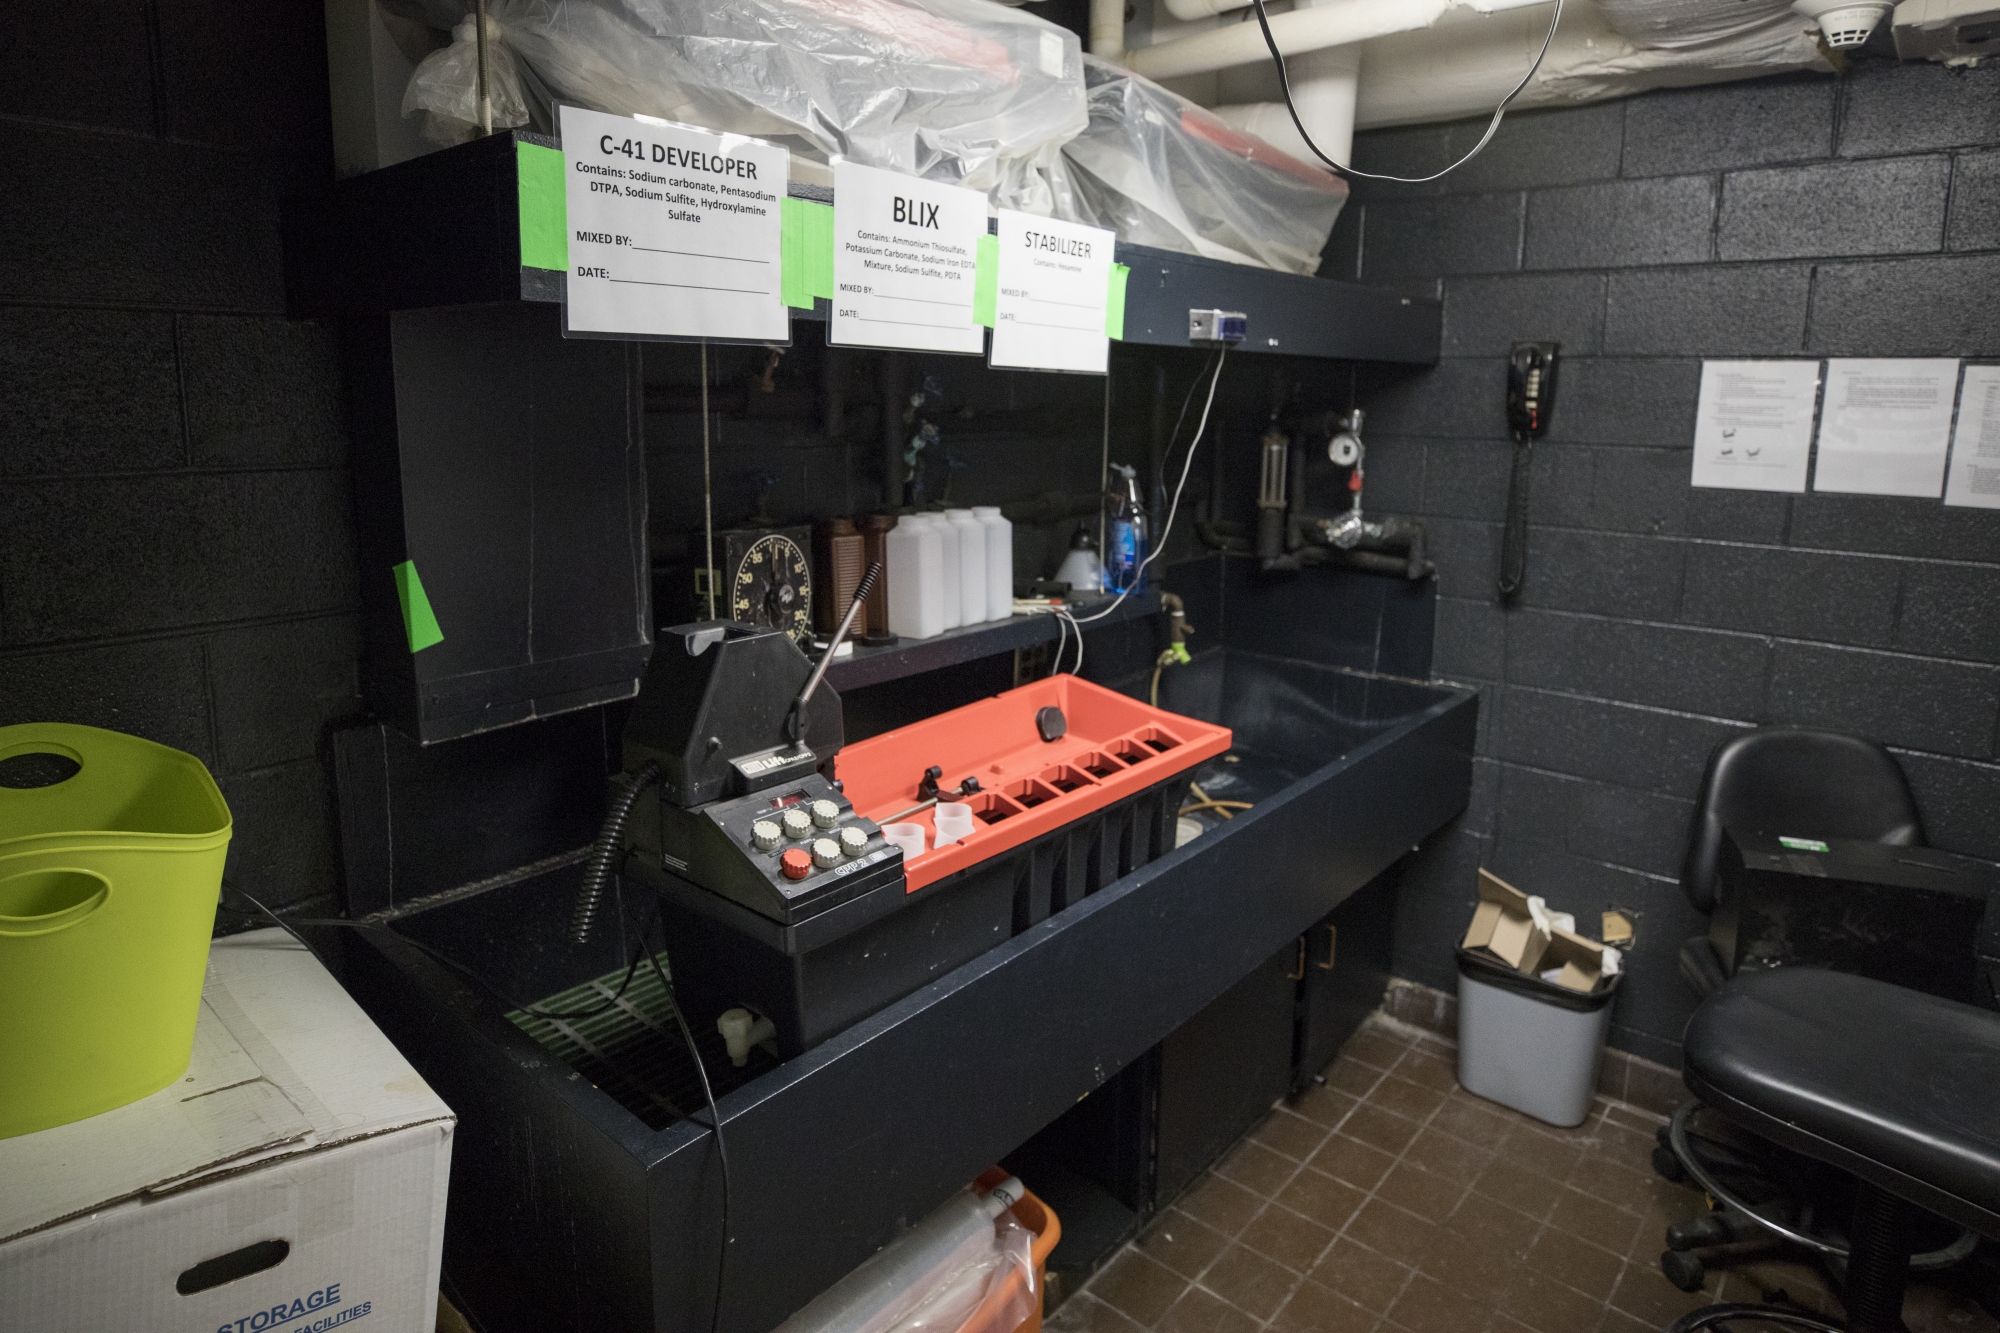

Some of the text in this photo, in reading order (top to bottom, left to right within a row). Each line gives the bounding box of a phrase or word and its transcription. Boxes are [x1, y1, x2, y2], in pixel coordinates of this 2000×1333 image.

[600, 135, 757, 179] C-41 DEVELOPER
[576, 162, 776, 202] Contains: Sodium carbonate, Pentasodium
[590, 181, 766, 216] DTPA, Sodium Sulfite, Hydroxylamine
[668, 210, 701, 223] Sulfate
[893, 196, 939, 229] BLIX
[576, 231, 632, 246] MIXED BY:
[858, 230, 967, 256] Contains: Ammonium Thiosulfate,
[1025, 232, 1091, 258] STABILIZER
[846, 243, 975, 269] Potassium Carbonate, Sodium Iron EDTA
[578, 266, 609, 279] DATE:
[864, 260, 961, 281] Mixture, Sodium Sulfite, PDTA
[840, 283, 874, 295] MIXED BY:
[1002, 288, 1019, 297] MIXED
[839, 309, 859, 318] DATE:
[1000, 313, 1016, 321] DATE:
[738, 598, 749, 609] 45
[835, 858, 869, 876] CPP 2
